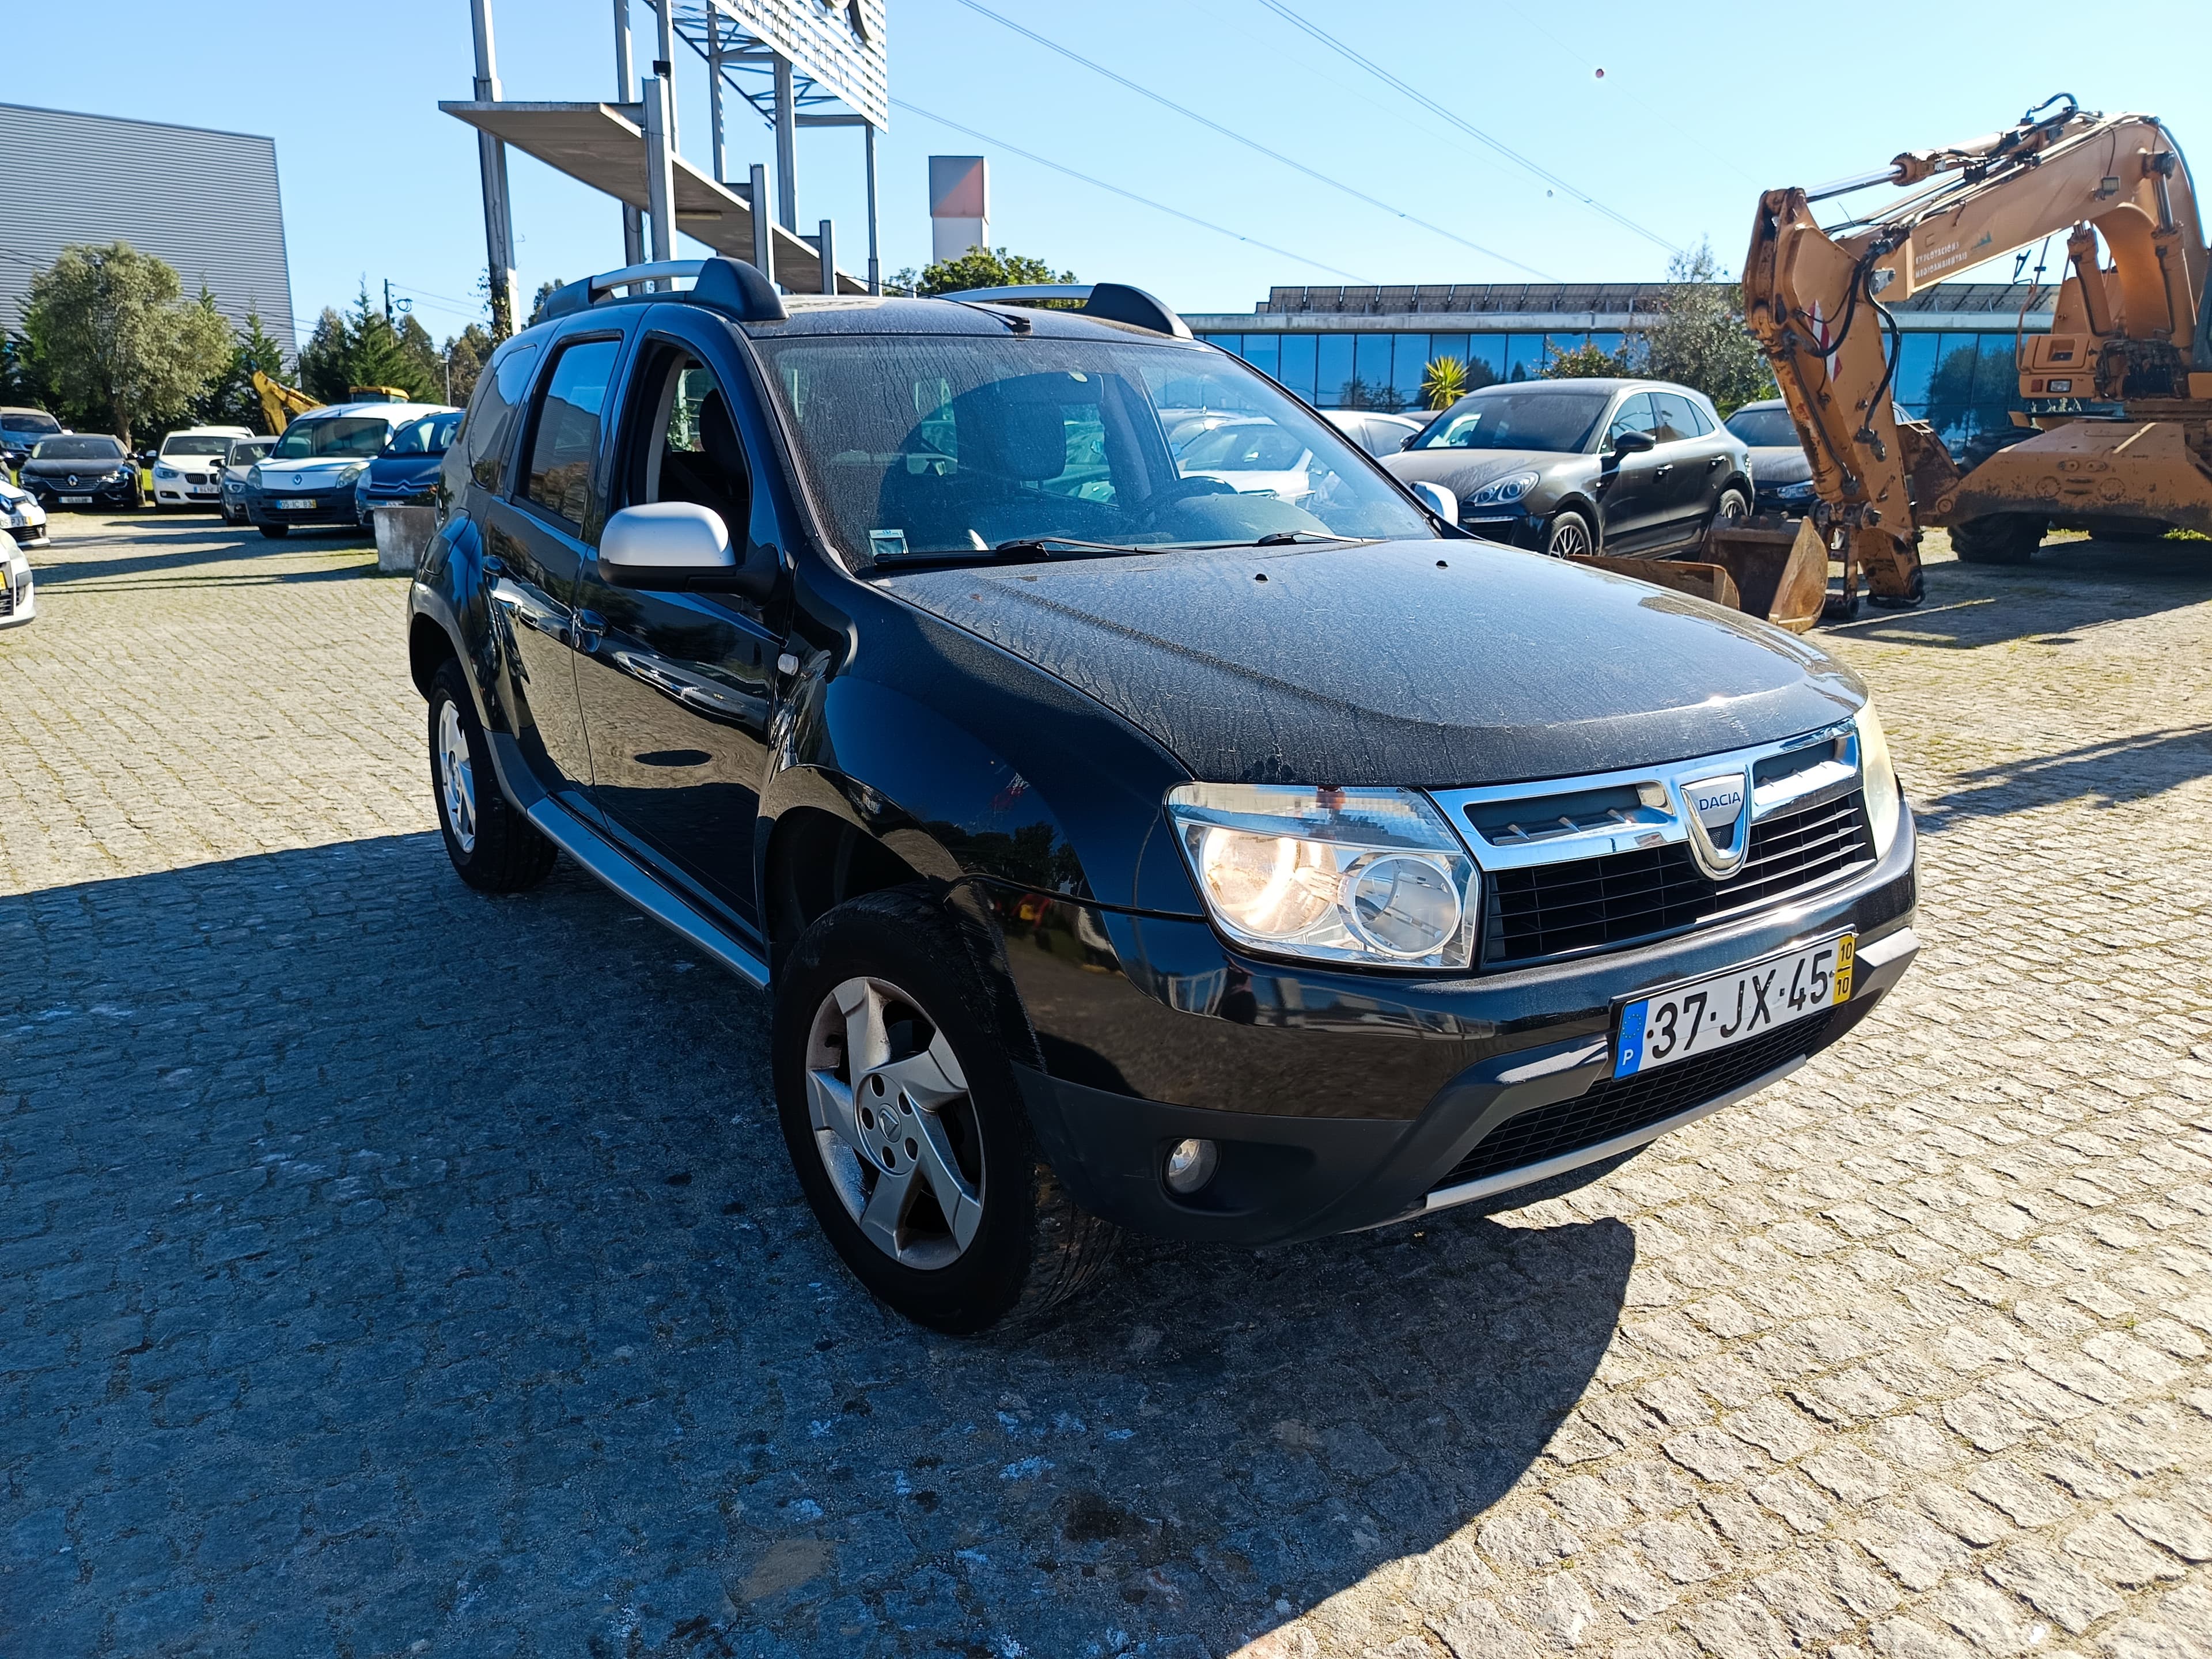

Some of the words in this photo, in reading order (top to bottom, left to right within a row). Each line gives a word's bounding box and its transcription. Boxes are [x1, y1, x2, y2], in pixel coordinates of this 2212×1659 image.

[1699, 792, 1741, 810] DACIA
[1840, 942, 1852, 962] 10
[1837, 976, 1849, 995] 10
[1622, 1049, 1634, 1066] P
